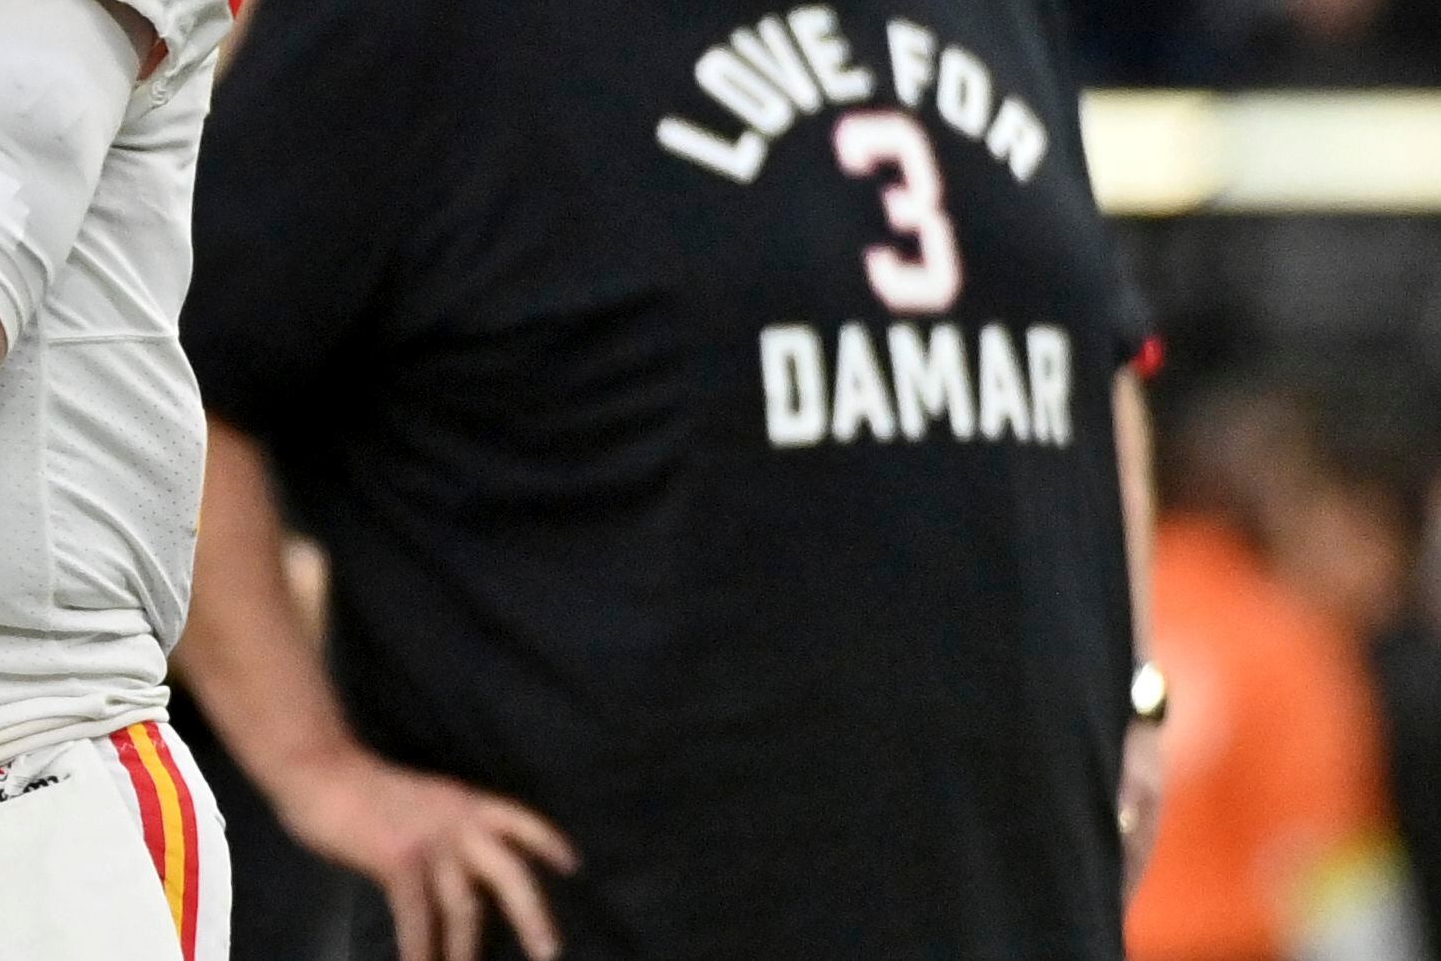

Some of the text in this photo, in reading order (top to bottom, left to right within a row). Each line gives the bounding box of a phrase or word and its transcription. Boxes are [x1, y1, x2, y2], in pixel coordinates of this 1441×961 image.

[657, 3, 1049, 184] LOVE FOR
[833, 110, 962, 314] 3
[760, 320, 1073, 449] DAMAR
